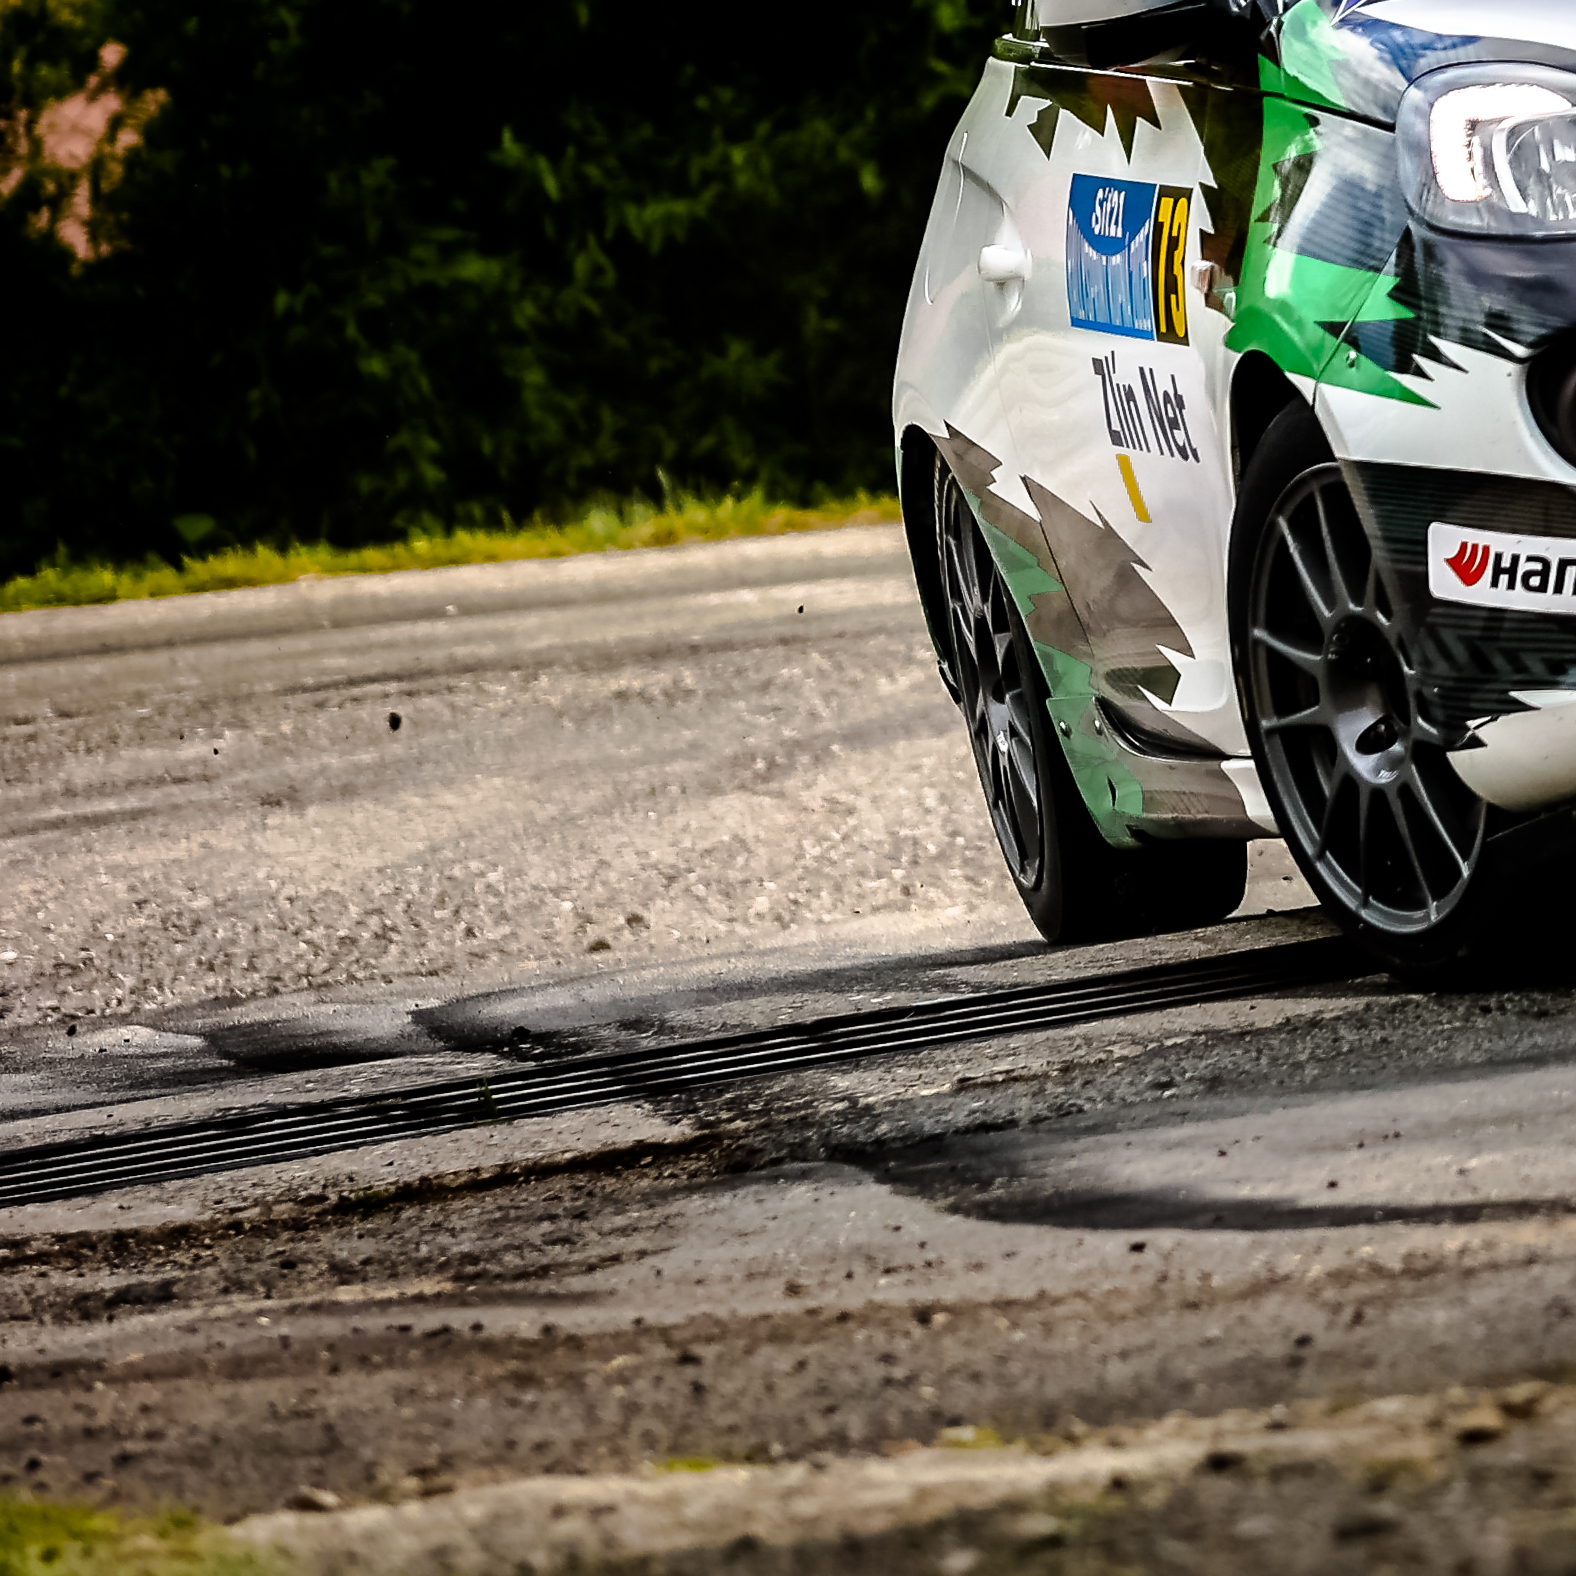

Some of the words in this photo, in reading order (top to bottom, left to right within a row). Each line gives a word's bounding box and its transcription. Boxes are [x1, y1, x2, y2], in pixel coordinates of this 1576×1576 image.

[1157, 197, 1188, 338] 73
[1092, 350, 1151, 453] Zlín
[1138, 366, 1201, 464] Net
